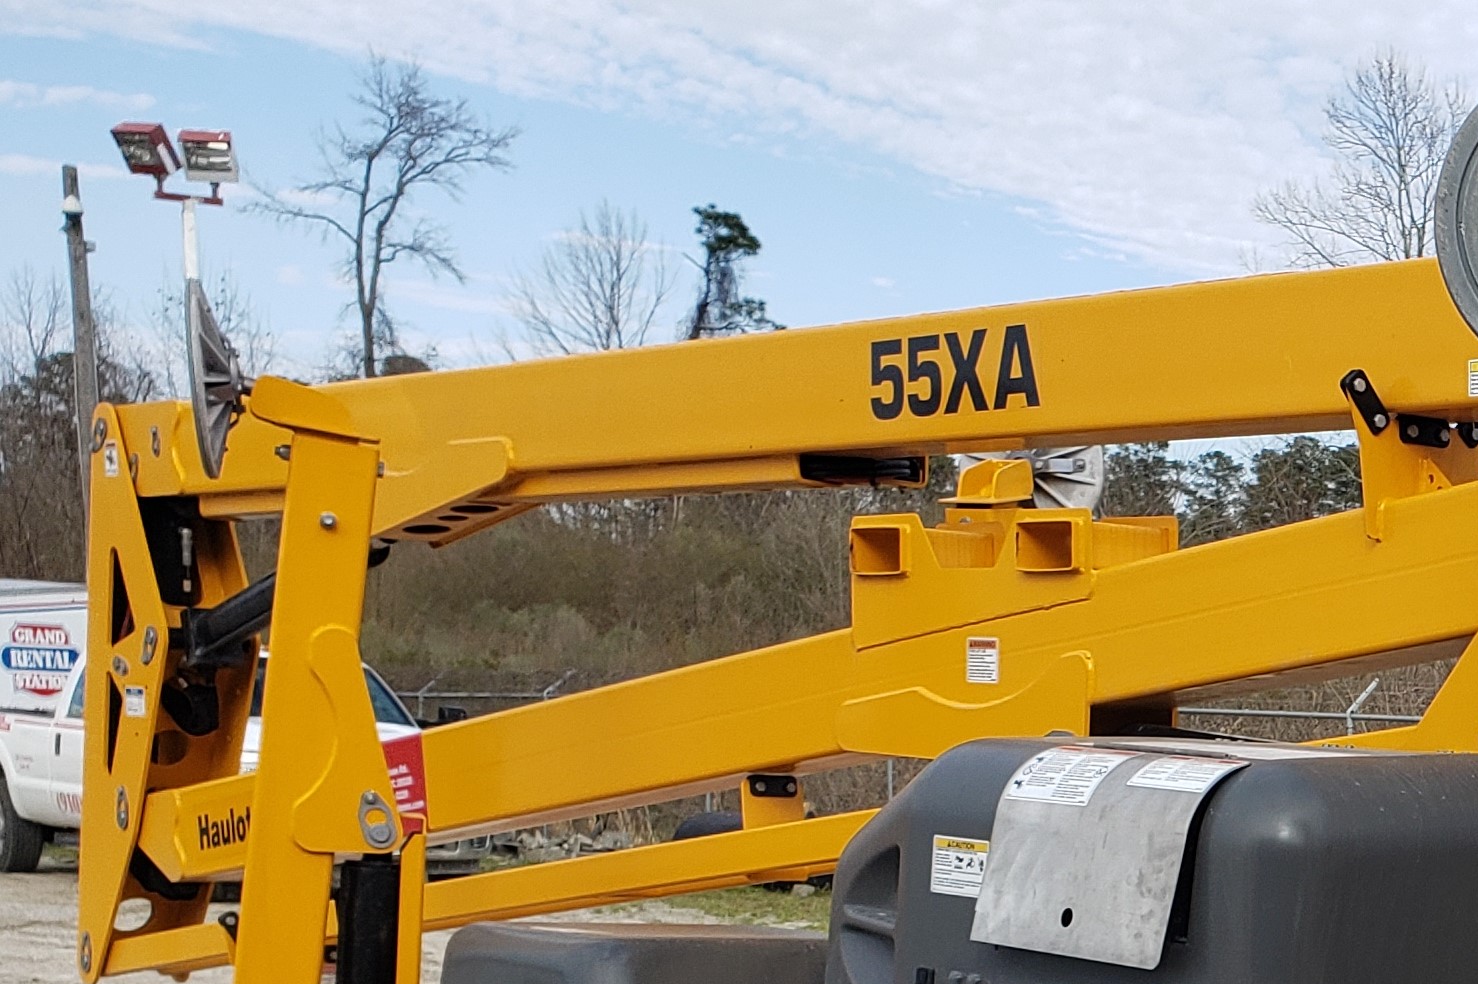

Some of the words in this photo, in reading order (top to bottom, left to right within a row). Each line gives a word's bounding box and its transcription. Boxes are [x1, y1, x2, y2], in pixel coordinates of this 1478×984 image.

[871, 324, 1040, 420] 55XA
[14, 627, 67, 645] GRAND
[9, 649, 75, 669] RENTAL
